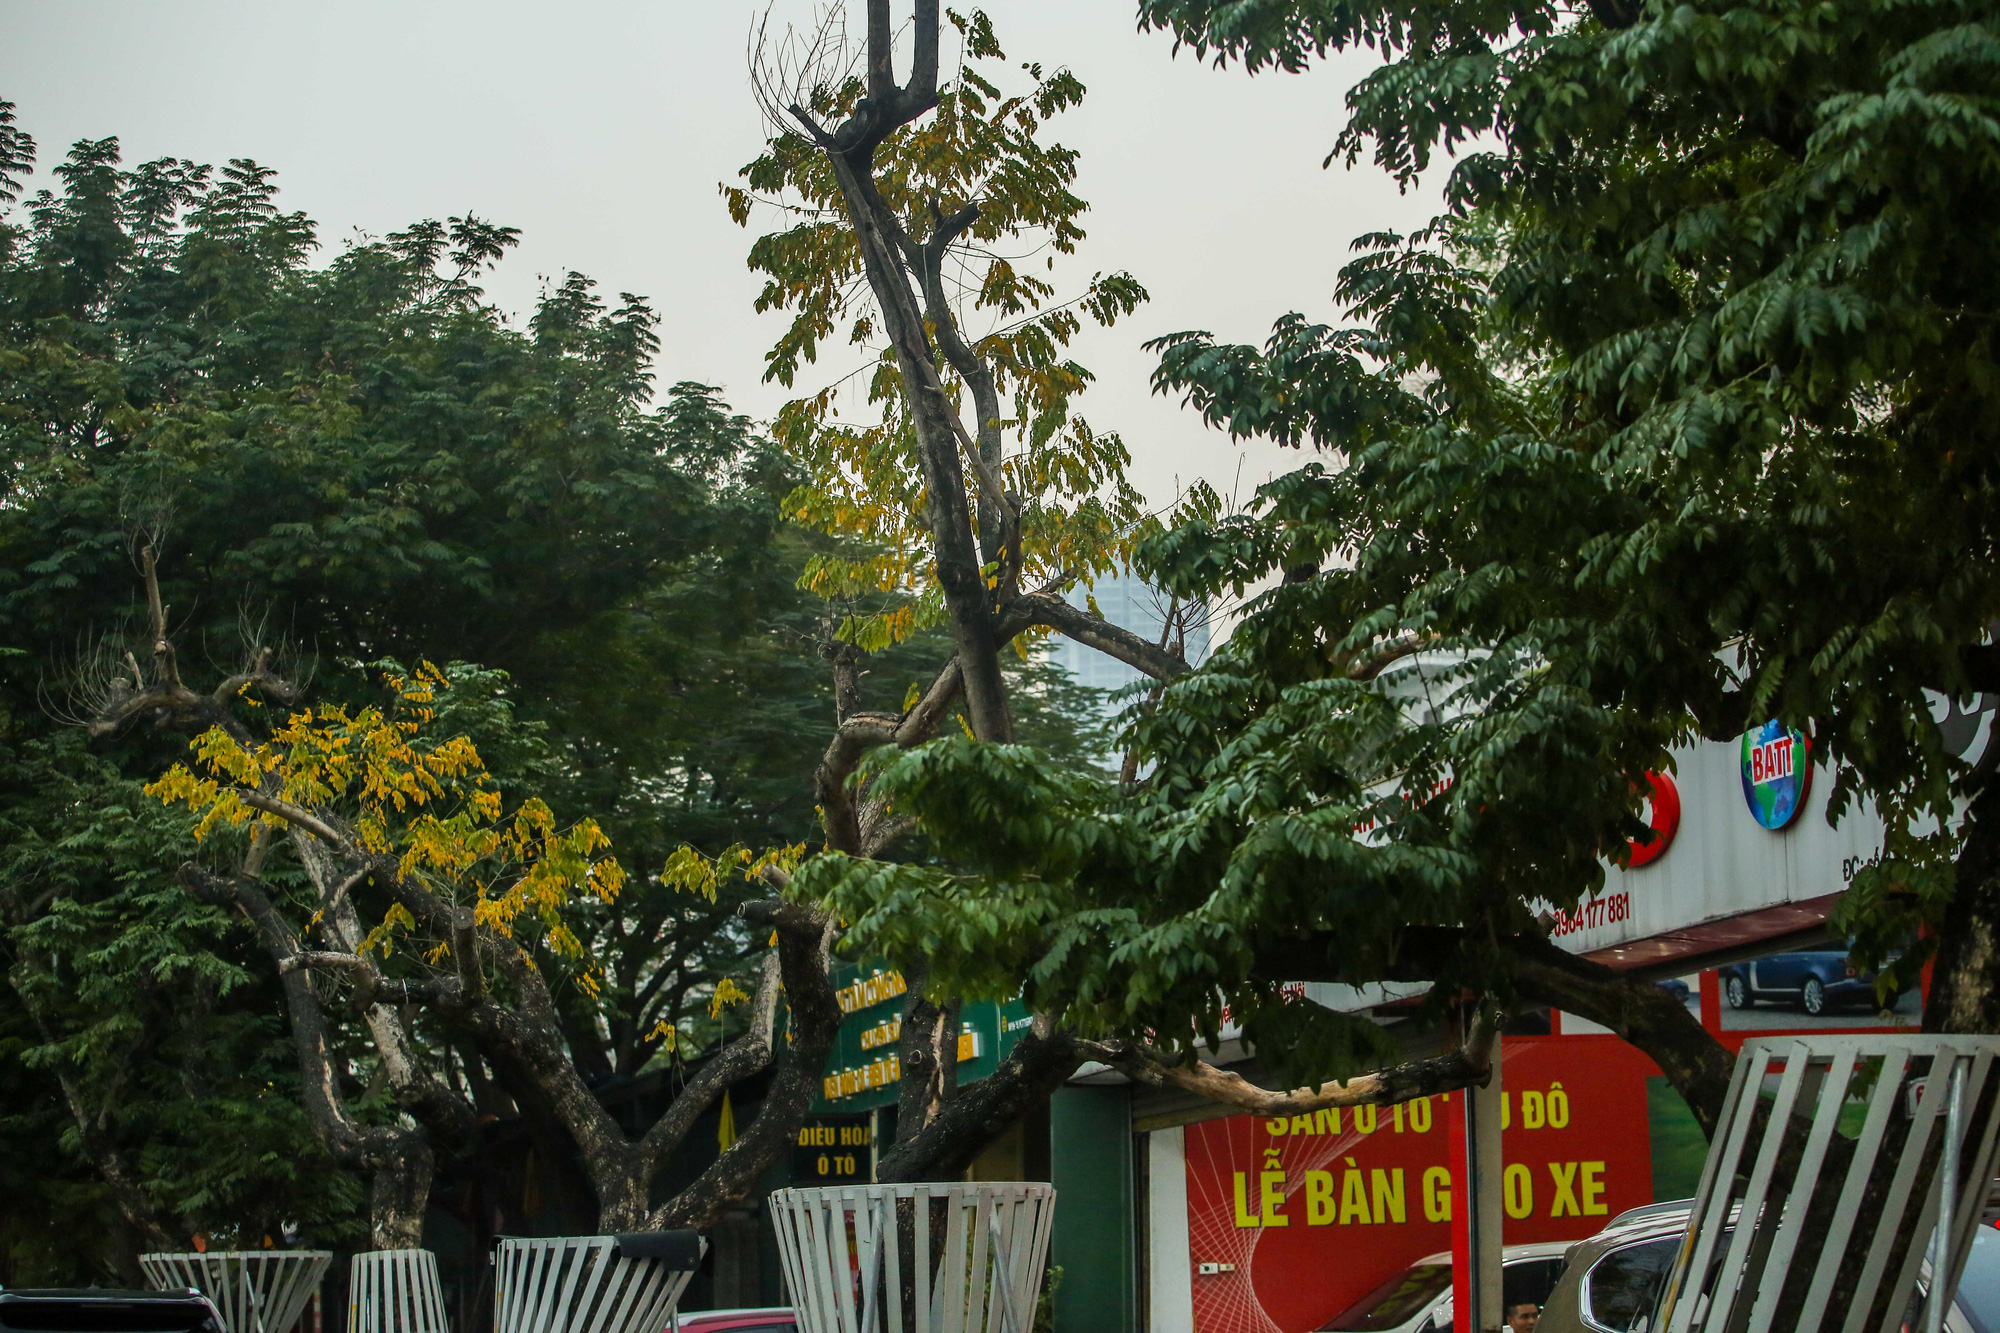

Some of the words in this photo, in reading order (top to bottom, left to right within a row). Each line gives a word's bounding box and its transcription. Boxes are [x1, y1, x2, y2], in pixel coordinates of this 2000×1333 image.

[1752, 738, 1793, 783] BATT
[1522, 1081, 1569, 1129] ĐÔ
[817, 1152, 829, 1175] Ô
[833, 1152, 855, 1175] TÔ
[1234, 1147, 1289, 1228] LỄ
[1305, 1156, 1406, 1226] BÀN
[1422, 1163, 1533, 1219] GO
[1548, 1161, 1609, 1217] XE
